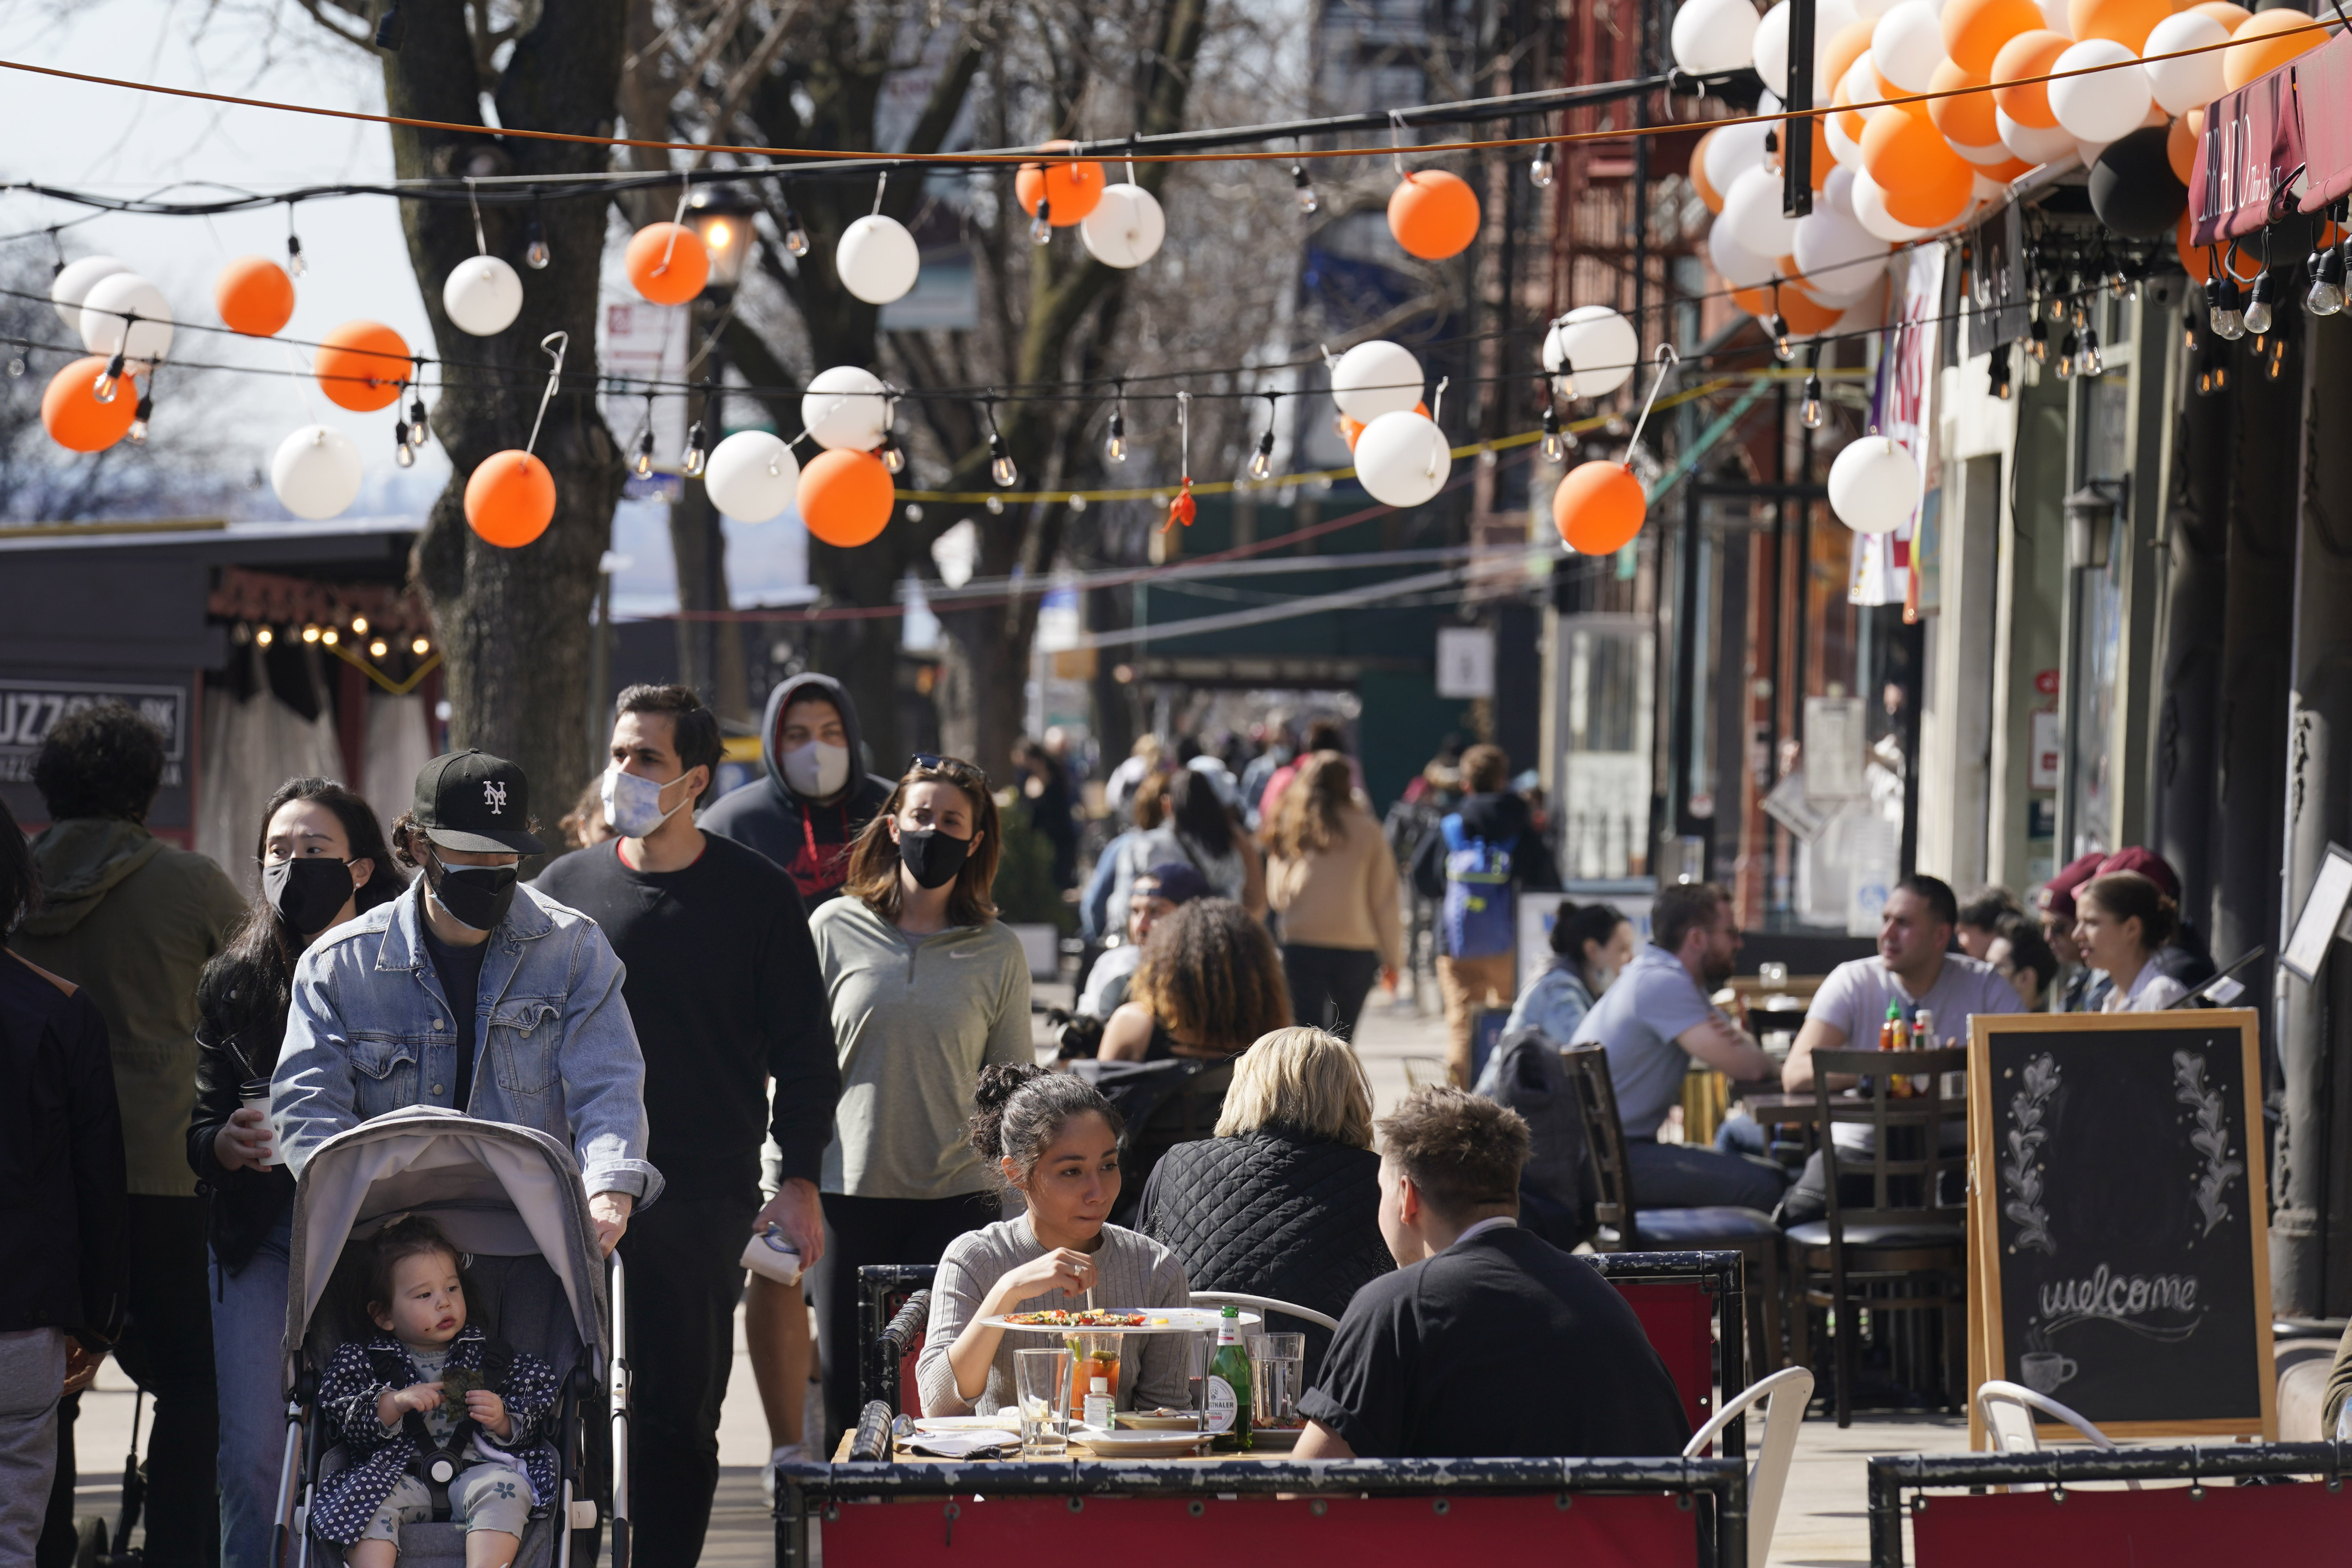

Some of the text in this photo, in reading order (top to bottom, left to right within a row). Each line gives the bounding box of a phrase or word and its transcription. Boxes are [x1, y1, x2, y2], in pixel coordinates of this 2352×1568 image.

[2199, 113, 2251, 222] BRADO
[2248, 164, 2261, 204] Thin
[483, 781, 507, 814] NY
[2039, 1262, 2198, 1318] welcome
